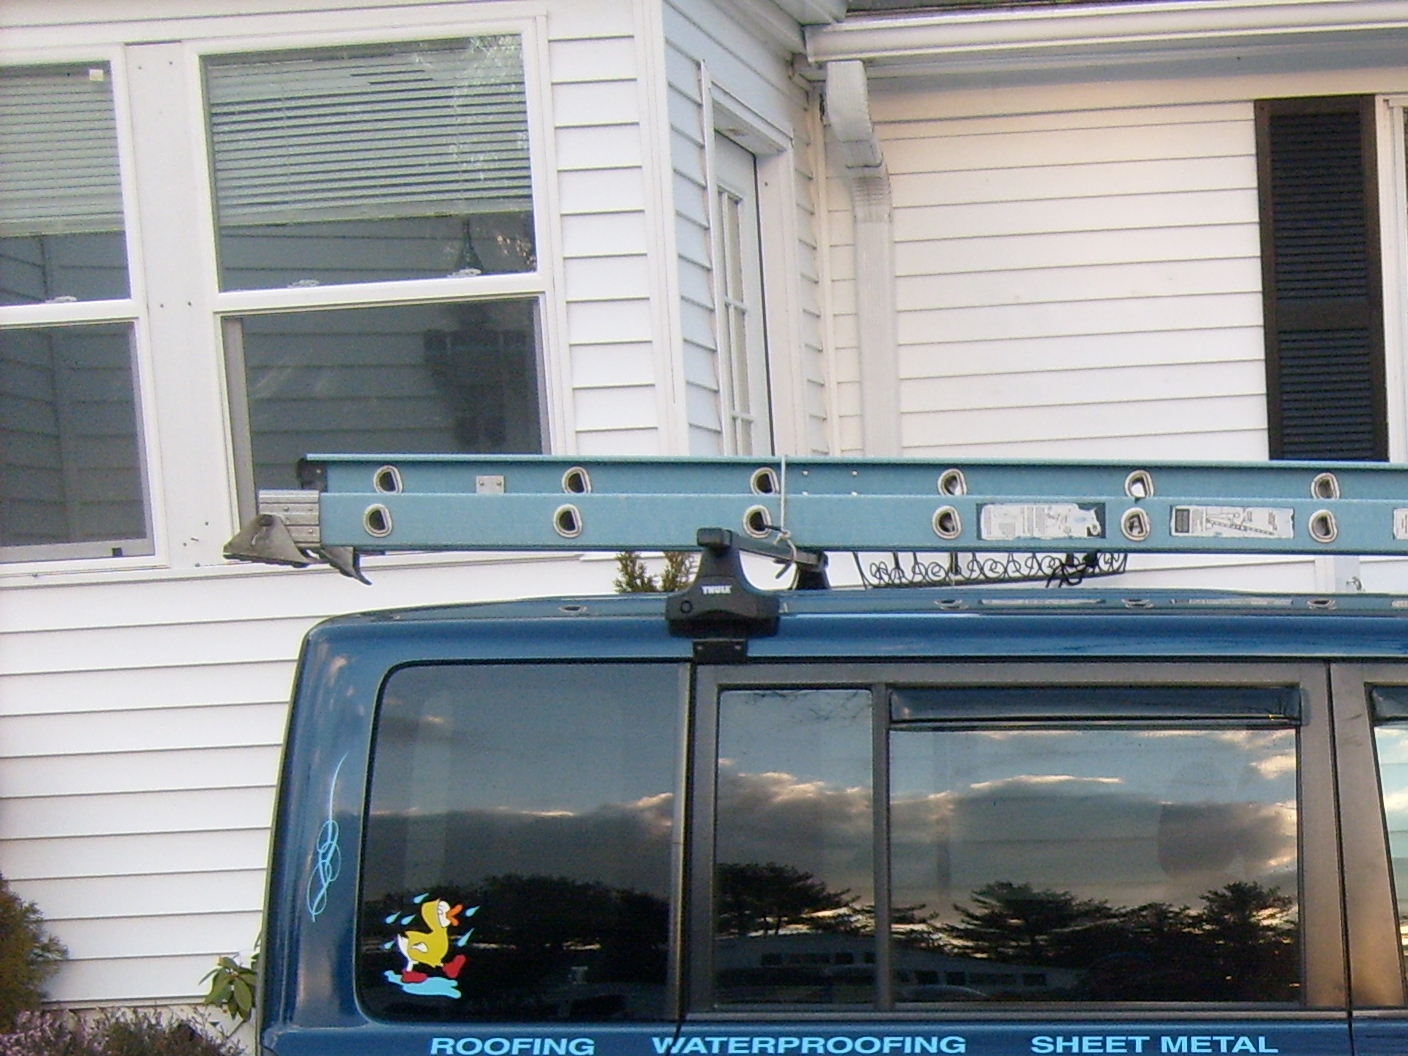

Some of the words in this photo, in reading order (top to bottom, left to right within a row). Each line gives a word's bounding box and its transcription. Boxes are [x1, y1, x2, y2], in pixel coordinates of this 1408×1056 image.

[430, 1037, 595, 1056] ROOFING
[652, 1036, 966, 1055] WATERPROOFING
[1031, 1036, 1150, 1054] SHEET
[1160, 1036, 1278, 1054] METAL
